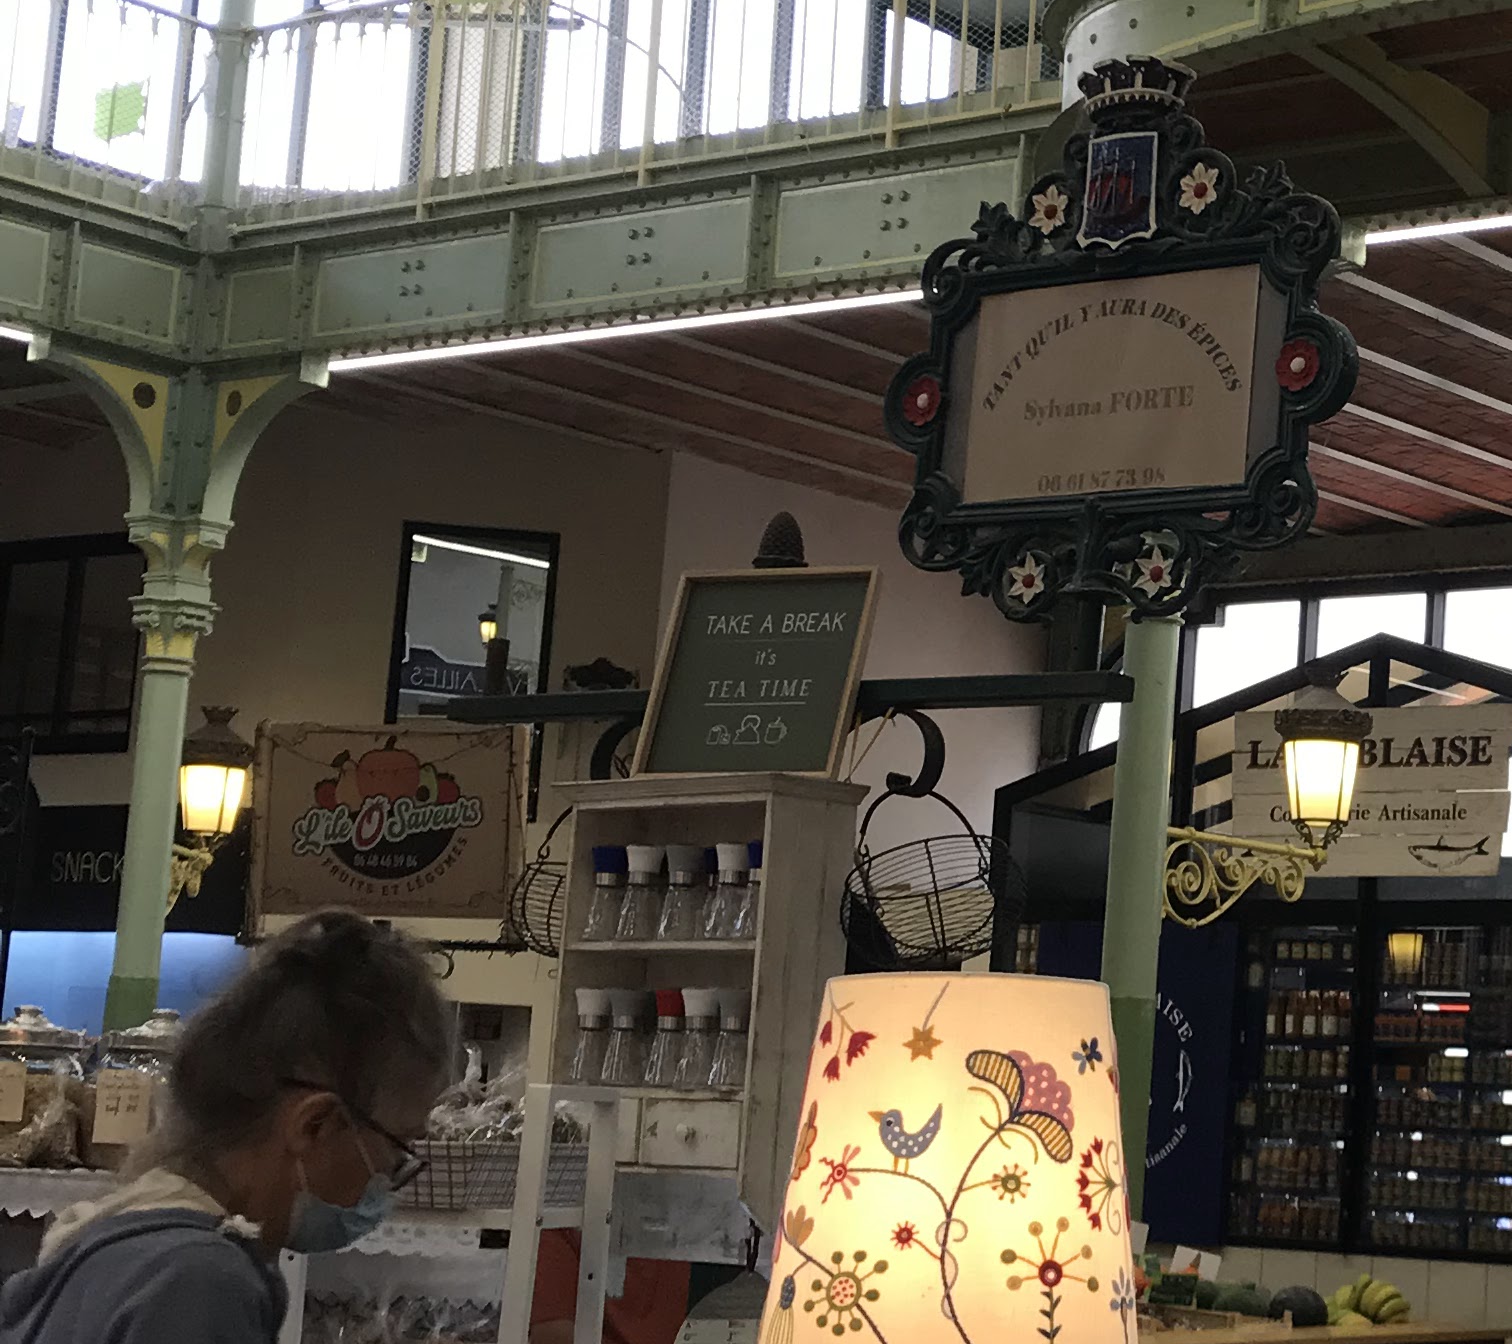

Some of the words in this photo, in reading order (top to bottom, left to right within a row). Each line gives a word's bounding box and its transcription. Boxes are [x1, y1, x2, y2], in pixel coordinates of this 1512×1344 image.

[982, 351, 1023, 411] TANT
[1024, 312, 1076, 360] QU'IL
[1079, 303, 1094, 325] Y
[1095, 297, 1148, 319] AURA
[1150, 302, 1191, 330] DES
[1187, 322, 1243, 393] ÉPICES
[1023, 398, 1102, 427] Sylvana
[1108, 384, 1195, 414] FORTE
[707, 614, 753, 635] TAKE
[759, 614, 774, 634] A
[781, 612, 847, 634] BREAK
[754, 648, 777, 665] it's
[708, 680, 747, 698] TEA
[760, 679, 813, 698] TIME
[386, 798, 480, 839] Saveurs
[1377, 804, 1468, 822] Artisanale
[50, 850, 124, 883] SNACK
[321, 856, 374, 895] FRUITS
[382, 884, 400, 897] ET
[407, 836, 468, 893] LÉGUMES
